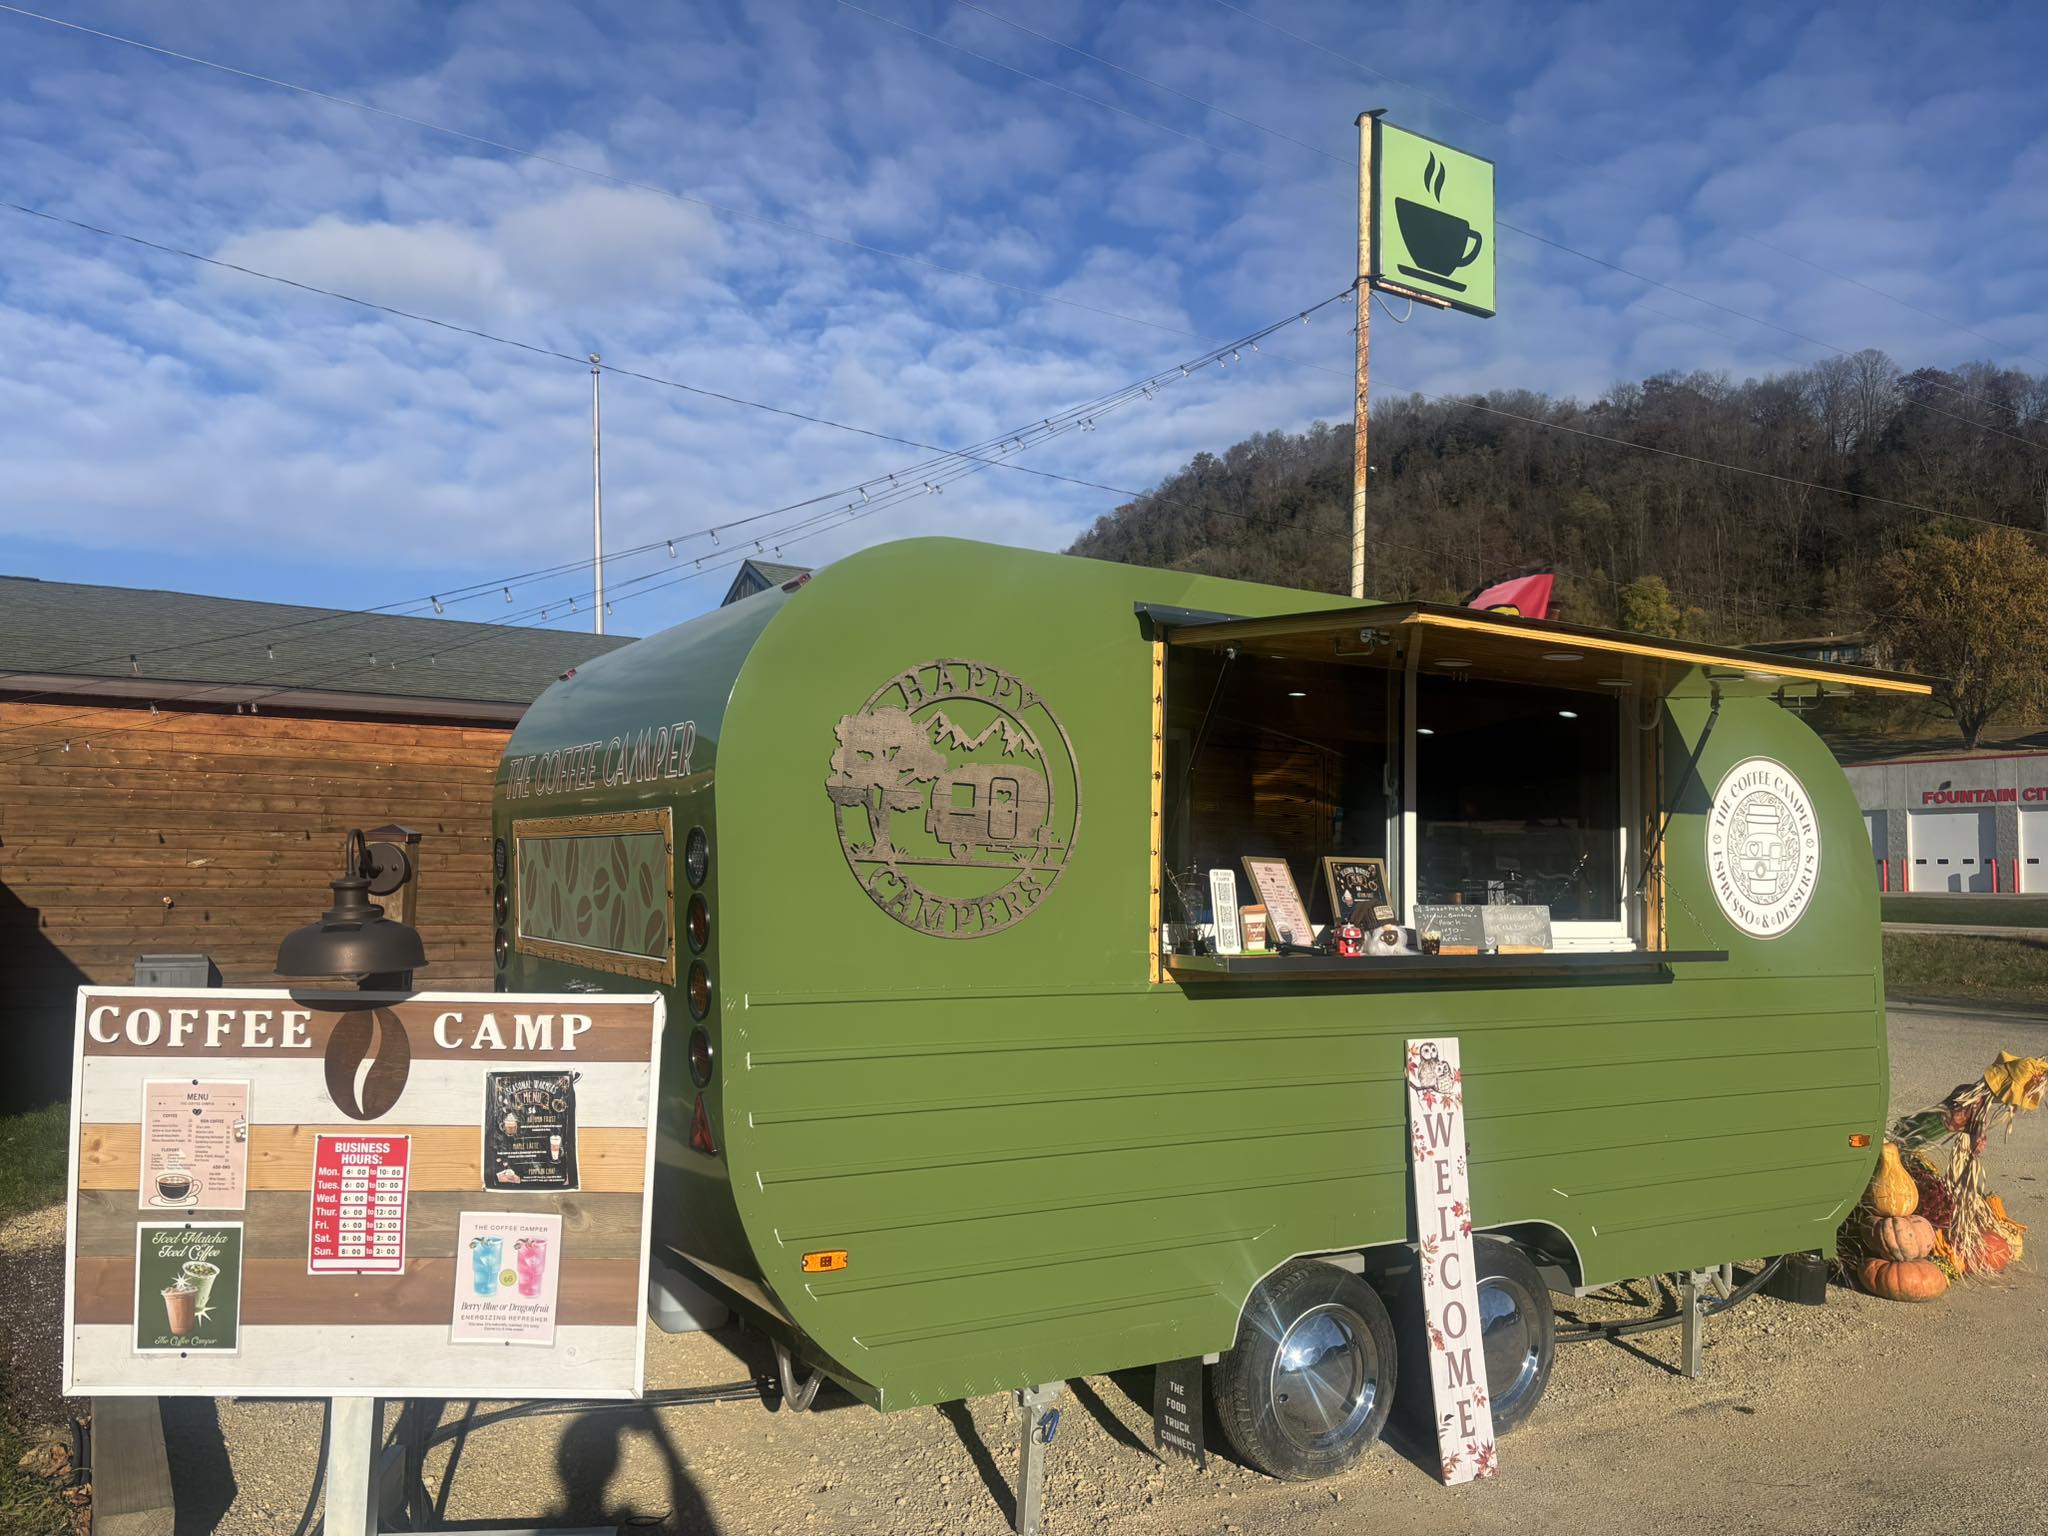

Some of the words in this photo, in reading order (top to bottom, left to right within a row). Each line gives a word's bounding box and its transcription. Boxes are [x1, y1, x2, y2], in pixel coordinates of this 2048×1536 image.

[896, 660, 1040, 713] HAPPY
[506, 755, 536, 800] THE
[535, 741, 603, 796] COFFEE
[602, 720, 696, 787] CAMPER
[1715, 798, 1732, 827] THE
[1730, 771, 1771, 798] COFFEE
[1774, 777, 1812, 835] CAMPER
[1922, 788, 2017, 804] FOUNTAIN
[1713, 851, 1755, 924] ESPRESSO
[1761, 914, 1769, 929] &
[1776, 855, 1815, 924] DESSERTS
[869, 869, 1043, 932] CAMPERS
[88, 1005, 312, 1048] COFFEE
[433, 1012, 593, 1051] CAMP
[187, 1093, 209, 1101] MENU
[522, 1091, 541, 1103] MENU
[335, 1142, 391, 1153] BUSINESS
[341, 1153, 383, 1165] HOURS:
[318, 1167, 340, 1176] Mon.
[317, 1180, 340, 1190] Tues.
[316, 1193, 338, 1203] Wed.
[316, 1207, 338, 1216] Thur.
[315, 1221, 329, 1230] Fri.
[152, 1231, 182, 1244] Iced
[181, 1231, 228, 1244] Matcha
[314, 1234, 332, 1243] Sat.
[366, 1234, 373, 1242] to
[158, 1245, 188, 1258] Iced
[188, 1244, 221, 1261] Coffee
[314, 1247, 334, 1256] Sun.
[1423, 1112, 1475, 1439] WELCOME
[461, 1302, 482, 1312] Berry
[483, 1302, 499, 1311] Blue
[499, 1303, 509, 1311] or
[509, 1303, 550, 1314] Dragonfruit
[1169, 1381, 1185, 1396] THE
[1166, 1397, 1187, 1415] FOOD
[1164, 1415, 1190, 1434] TRUCK
[1161, 1429, 1196, 1453] CONNECT
